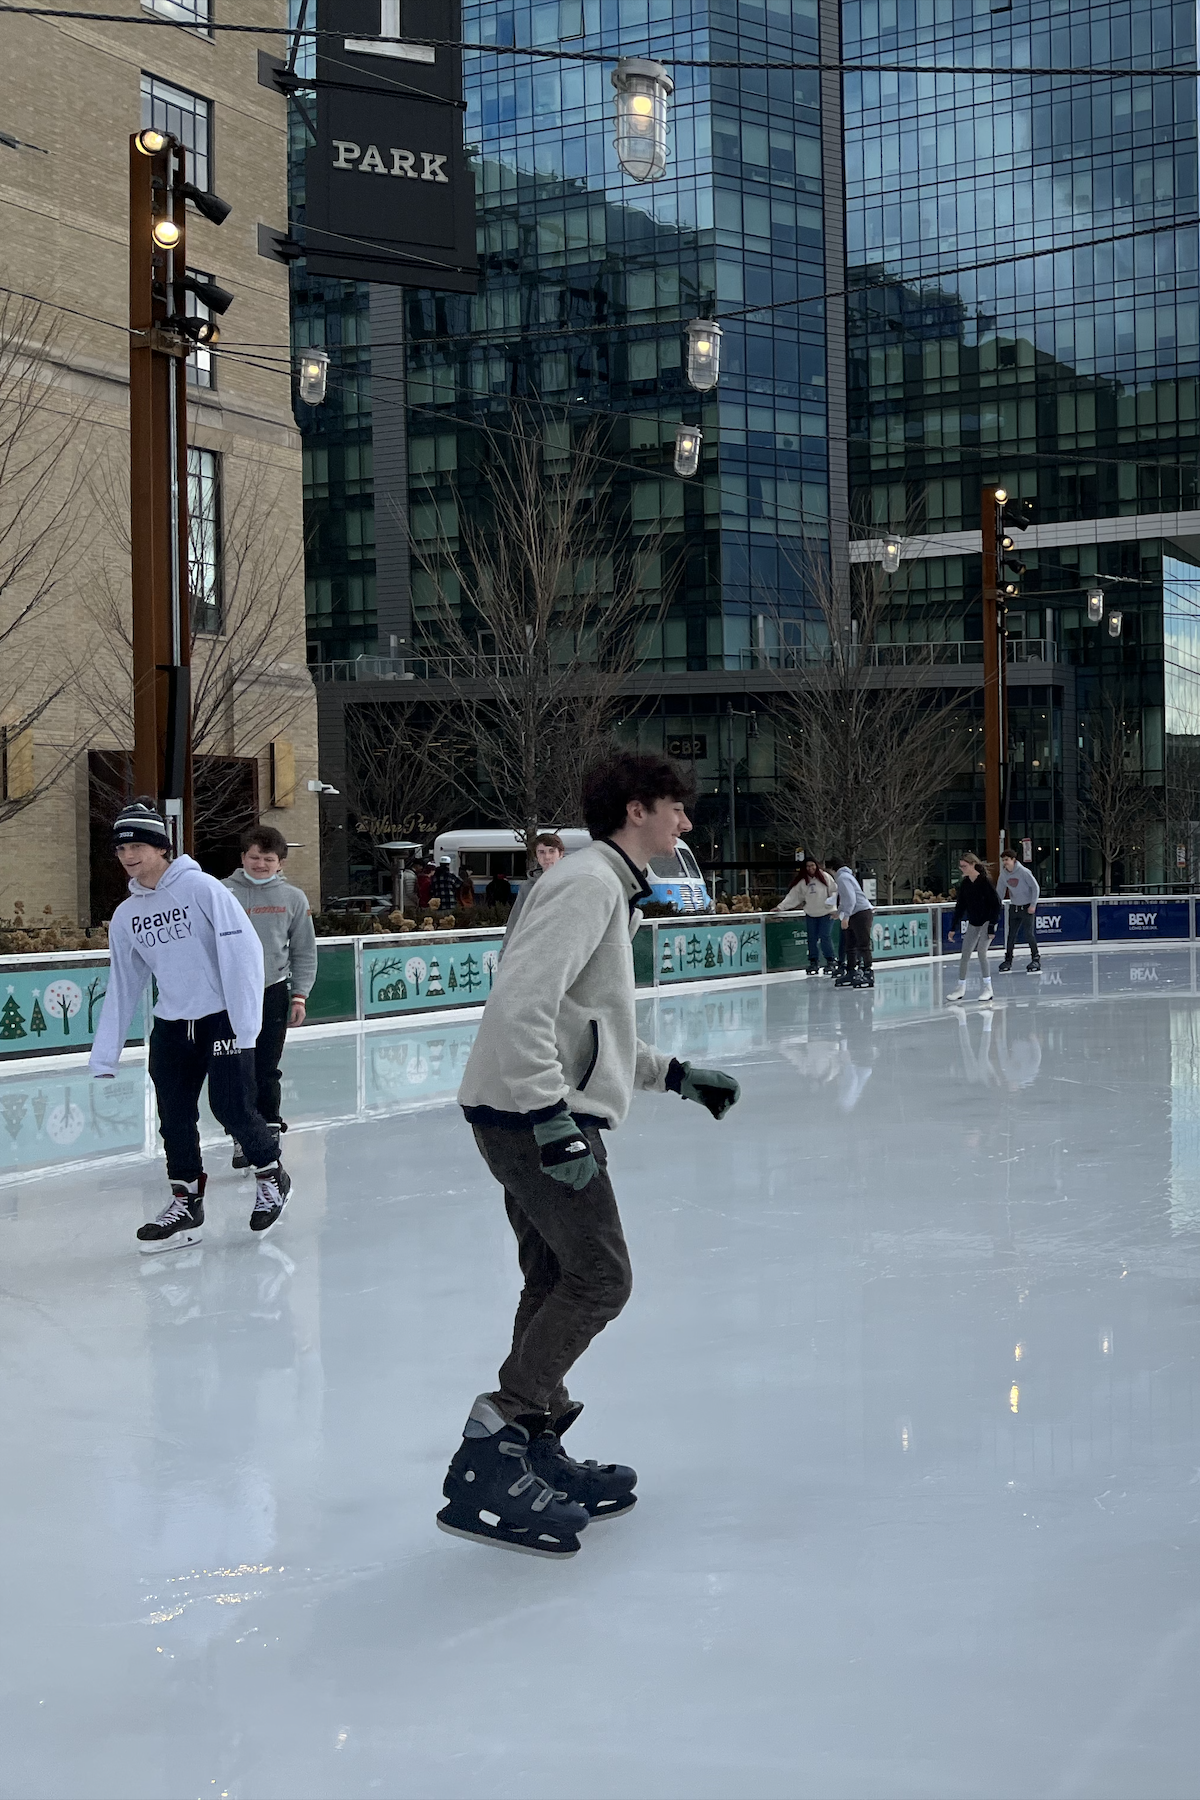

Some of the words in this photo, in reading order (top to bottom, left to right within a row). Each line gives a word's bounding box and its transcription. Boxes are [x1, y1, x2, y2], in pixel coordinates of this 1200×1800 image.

[332, 140, 449, 183] PARK
[670, 741, 702, 754] CB2
[131, 905, 189, 934] Beaver
[1036, 916, 1061, 929] BEVY
[1129, 913, 1157, 925] BEVY
[136, 921, 192, 948] HOCKEY
